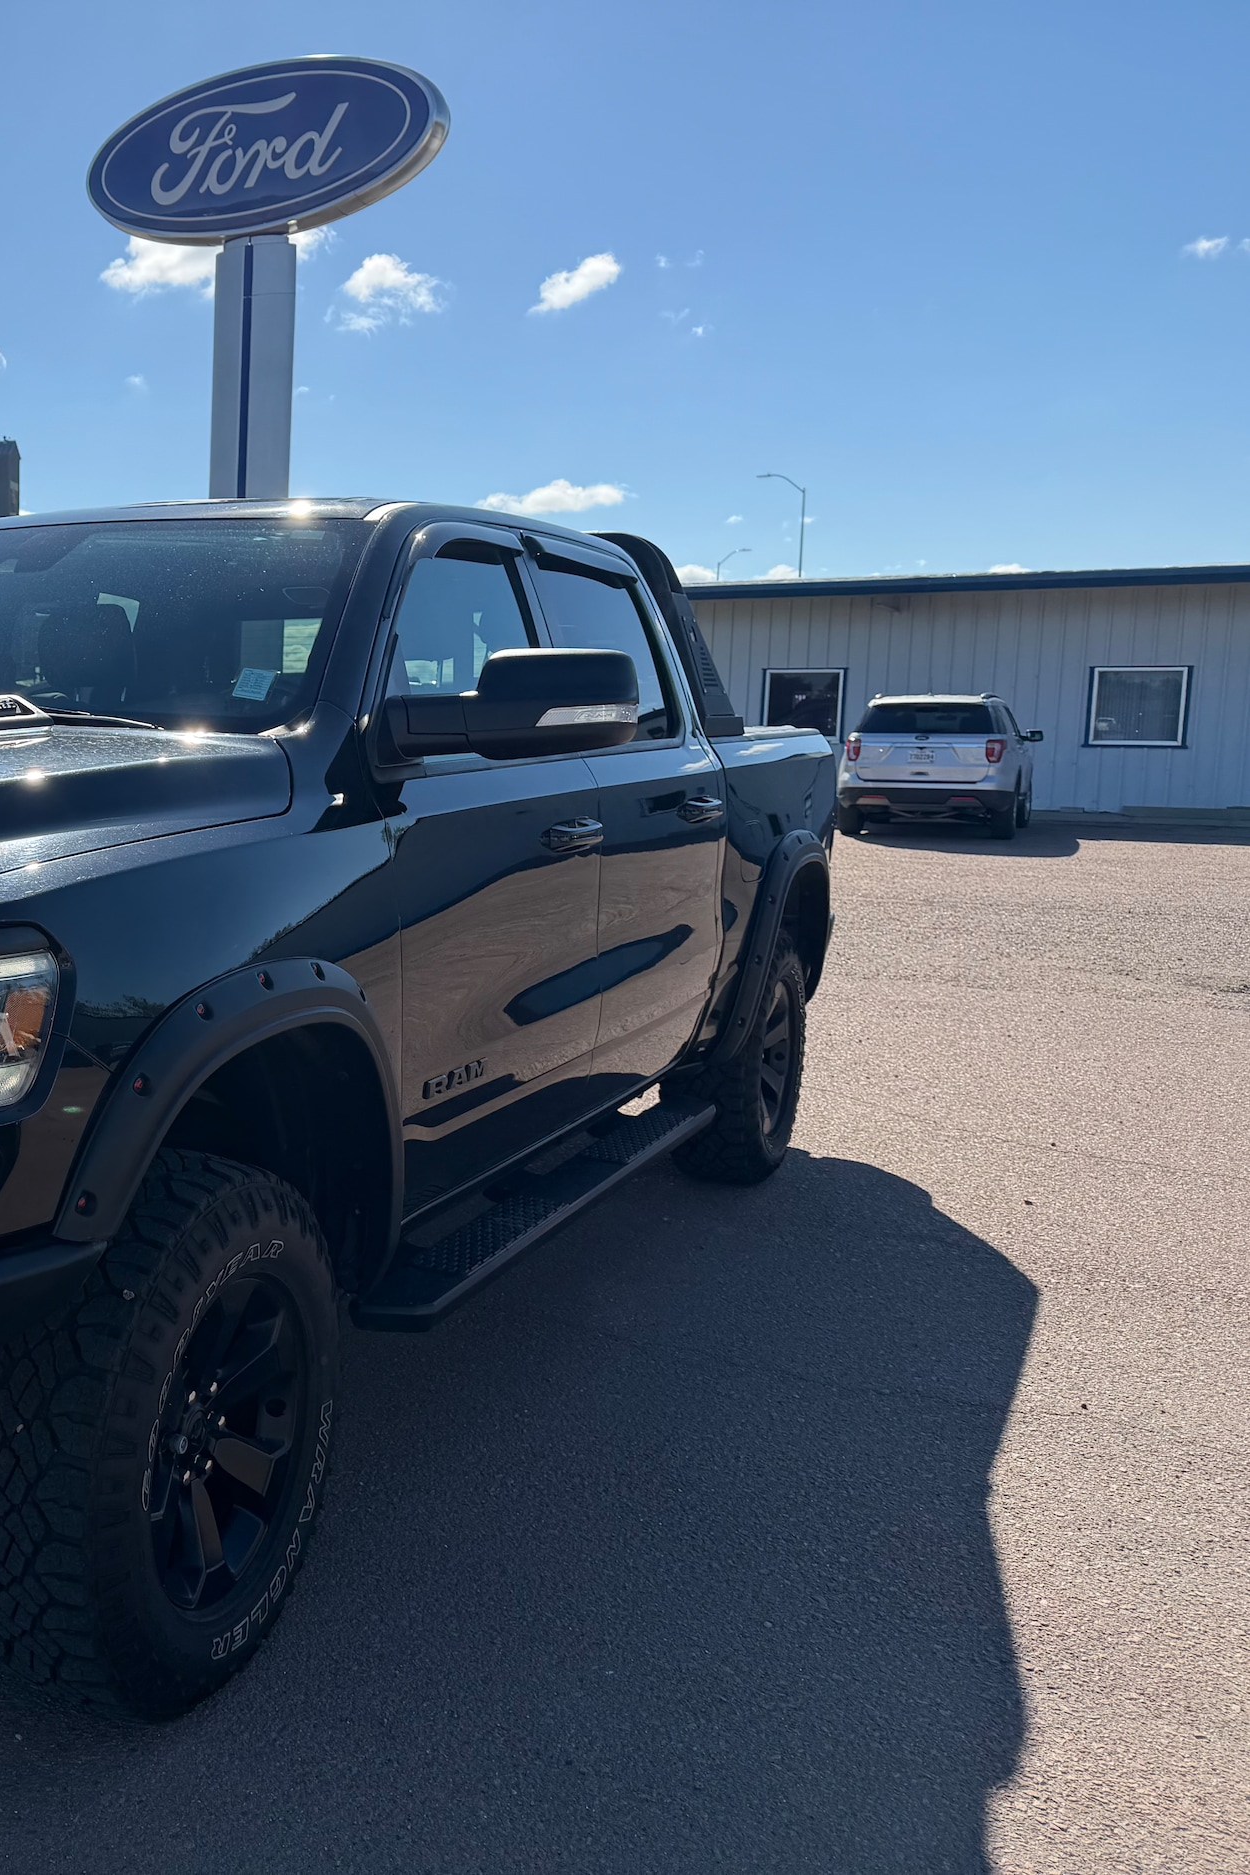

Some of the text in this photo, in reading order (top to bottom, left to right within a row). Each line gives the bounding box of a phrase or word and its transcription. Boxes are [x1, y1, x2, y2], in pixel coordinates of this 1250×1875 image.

[151, 91, 349, 206] Ford
[422, 1056, 488, 1100] RAM
[211, 1400, 333, 1660] WRANGLER
